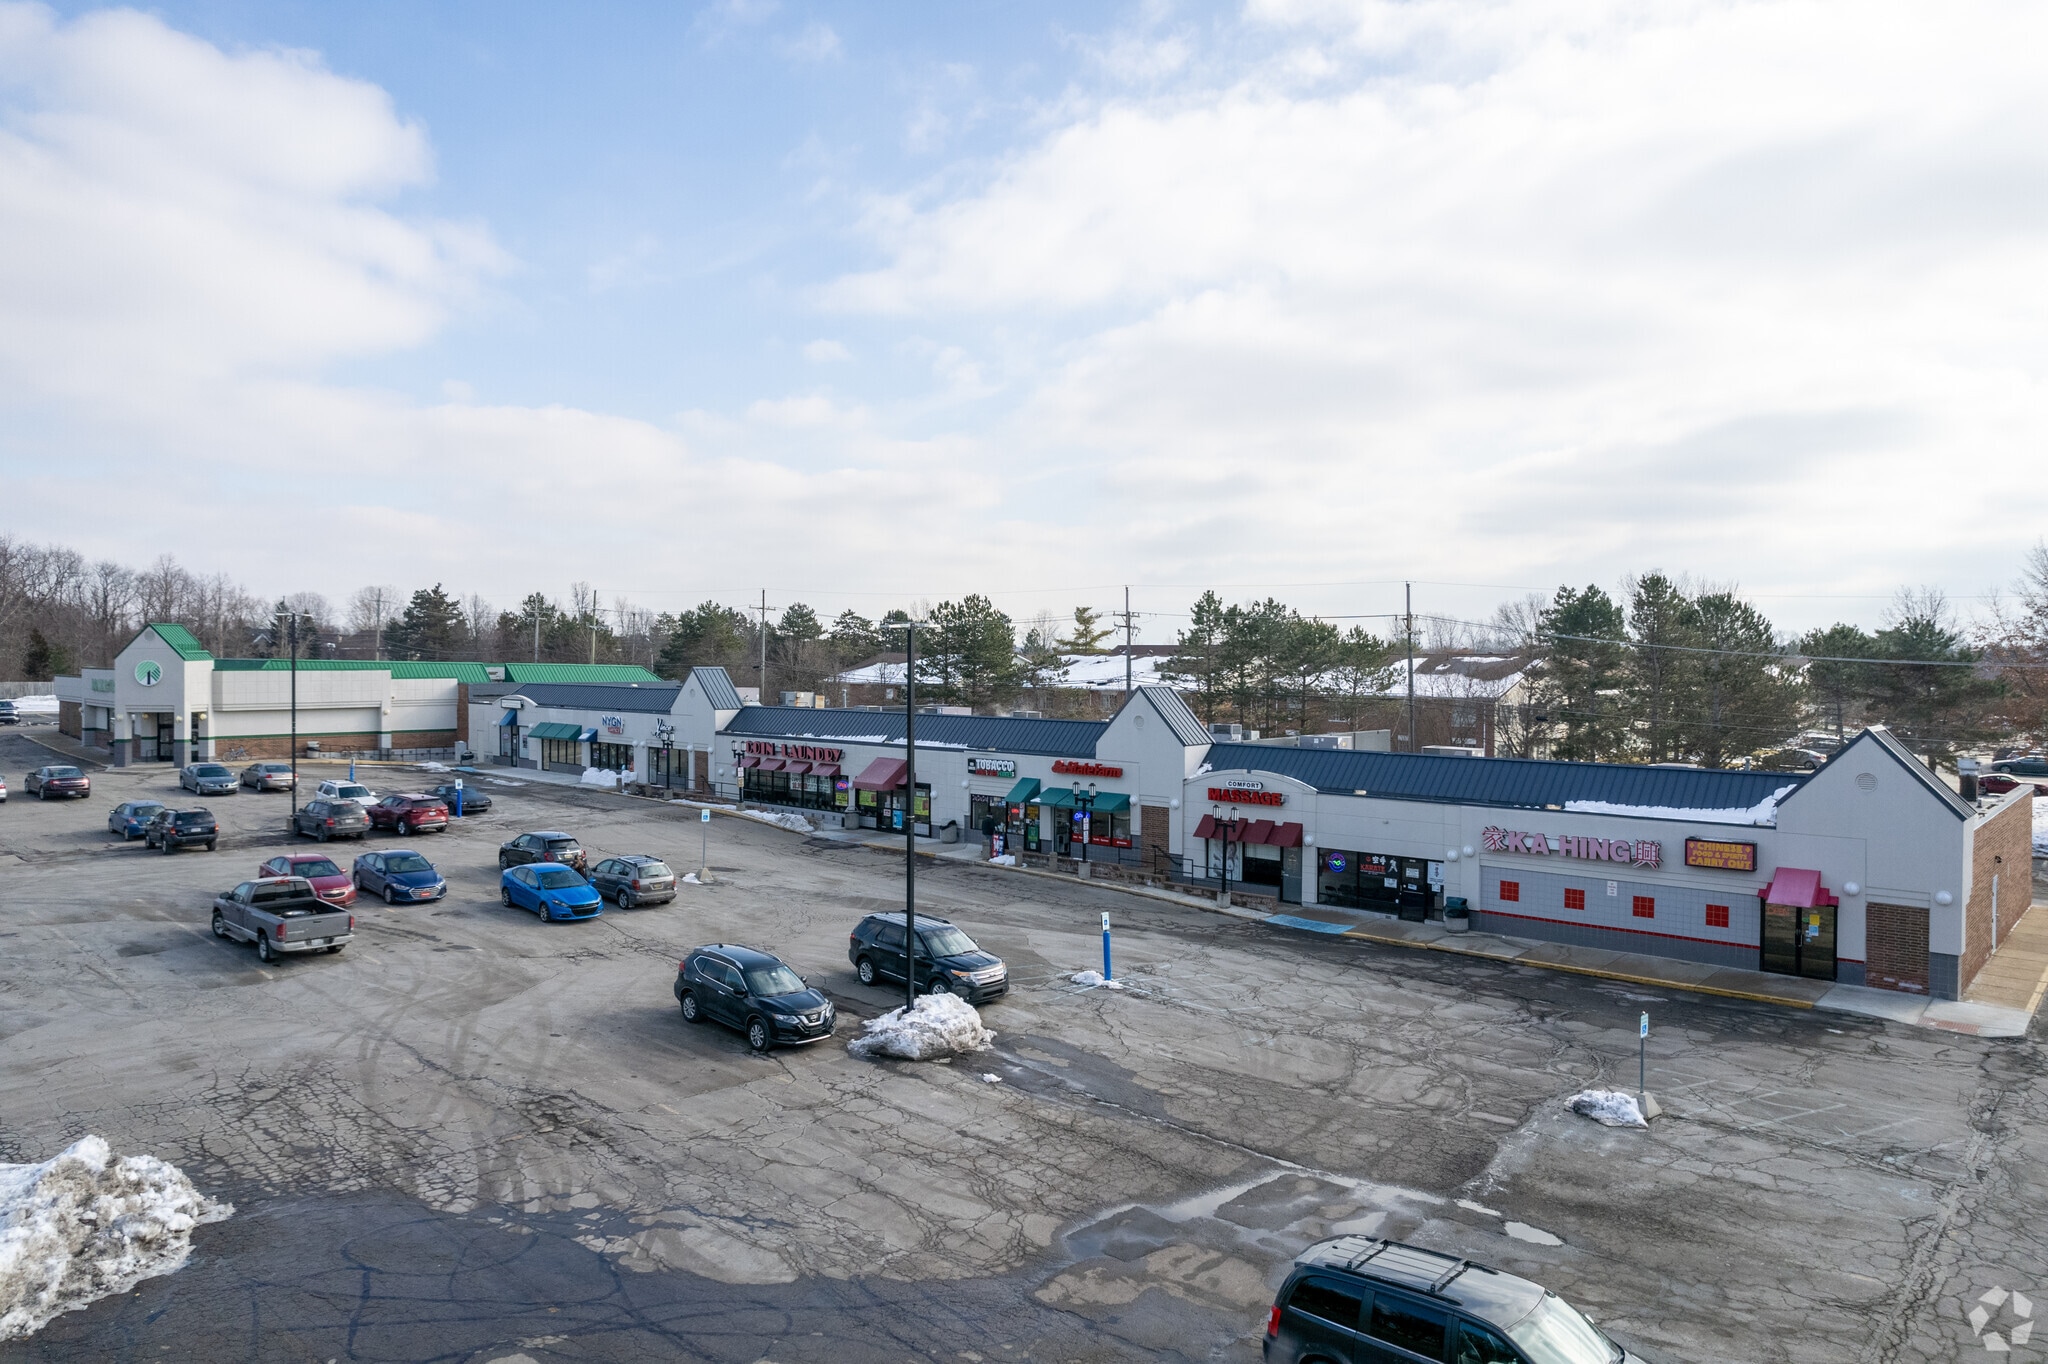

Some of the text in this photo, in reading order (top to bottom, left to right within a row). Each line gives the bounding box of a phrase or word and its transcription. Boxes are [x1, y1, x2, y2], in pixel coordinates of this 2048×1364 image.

[746, 741, 841, 762] COIN LAUNDRY
[976, 759, 1014, 771] TOBACCO
[1208, 788, 1283, 806] MASSAGE
[1508, 831, 1549, 855] KA
[1558, 835, 1632, 863] HING
[1697, 842, 1743, 853] CHINESE
[1360, 863, 1386, 873] KARATE
[1689, 857, 1751, 870] CARRY OUT
